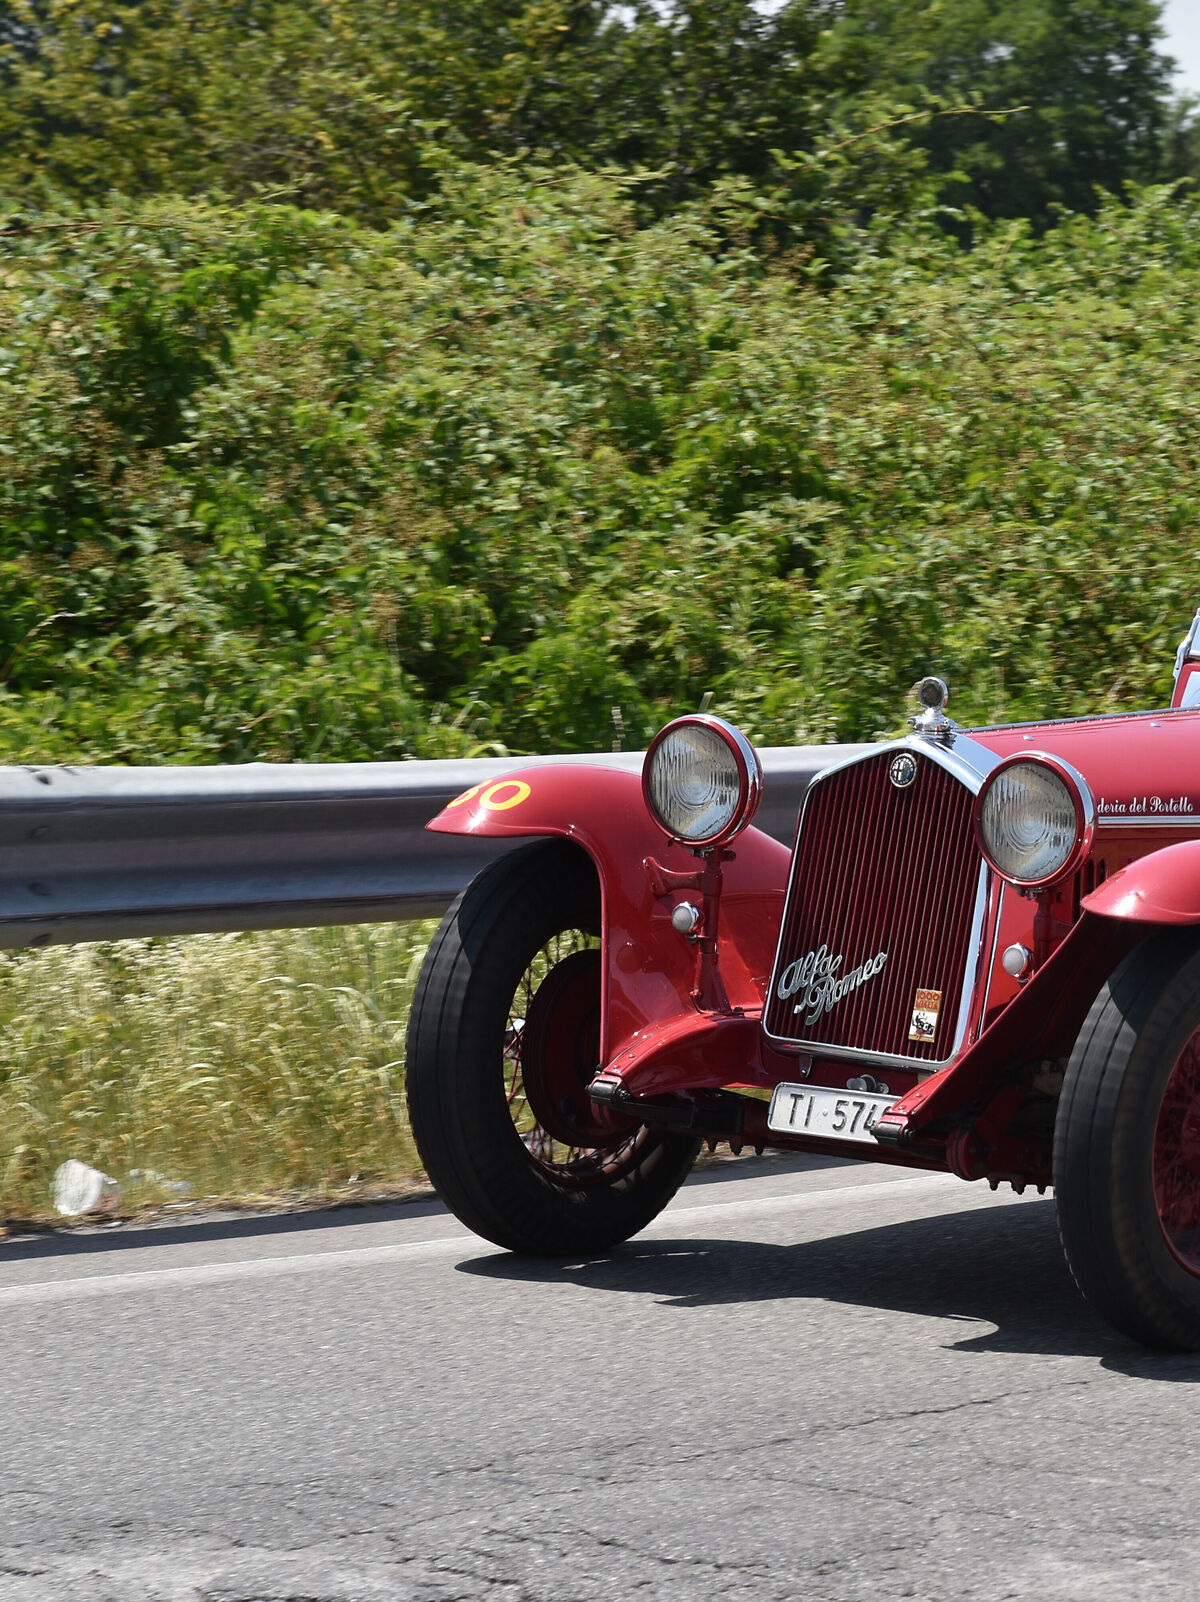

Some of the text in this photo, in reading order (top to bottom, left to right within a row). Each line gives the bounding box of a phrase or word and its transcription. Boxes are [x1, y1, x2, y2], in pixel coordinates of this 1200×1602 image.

[1129, 797, 1146, 813] del
[1149, 796, 1194, 813] Portello
[777, 944, 843, 1002] Alfa
[795, 951, 888, 1026] Romeo
[916, 990, 940, 1001] 1000
[789, 1093, 891, 1134] TI 574
